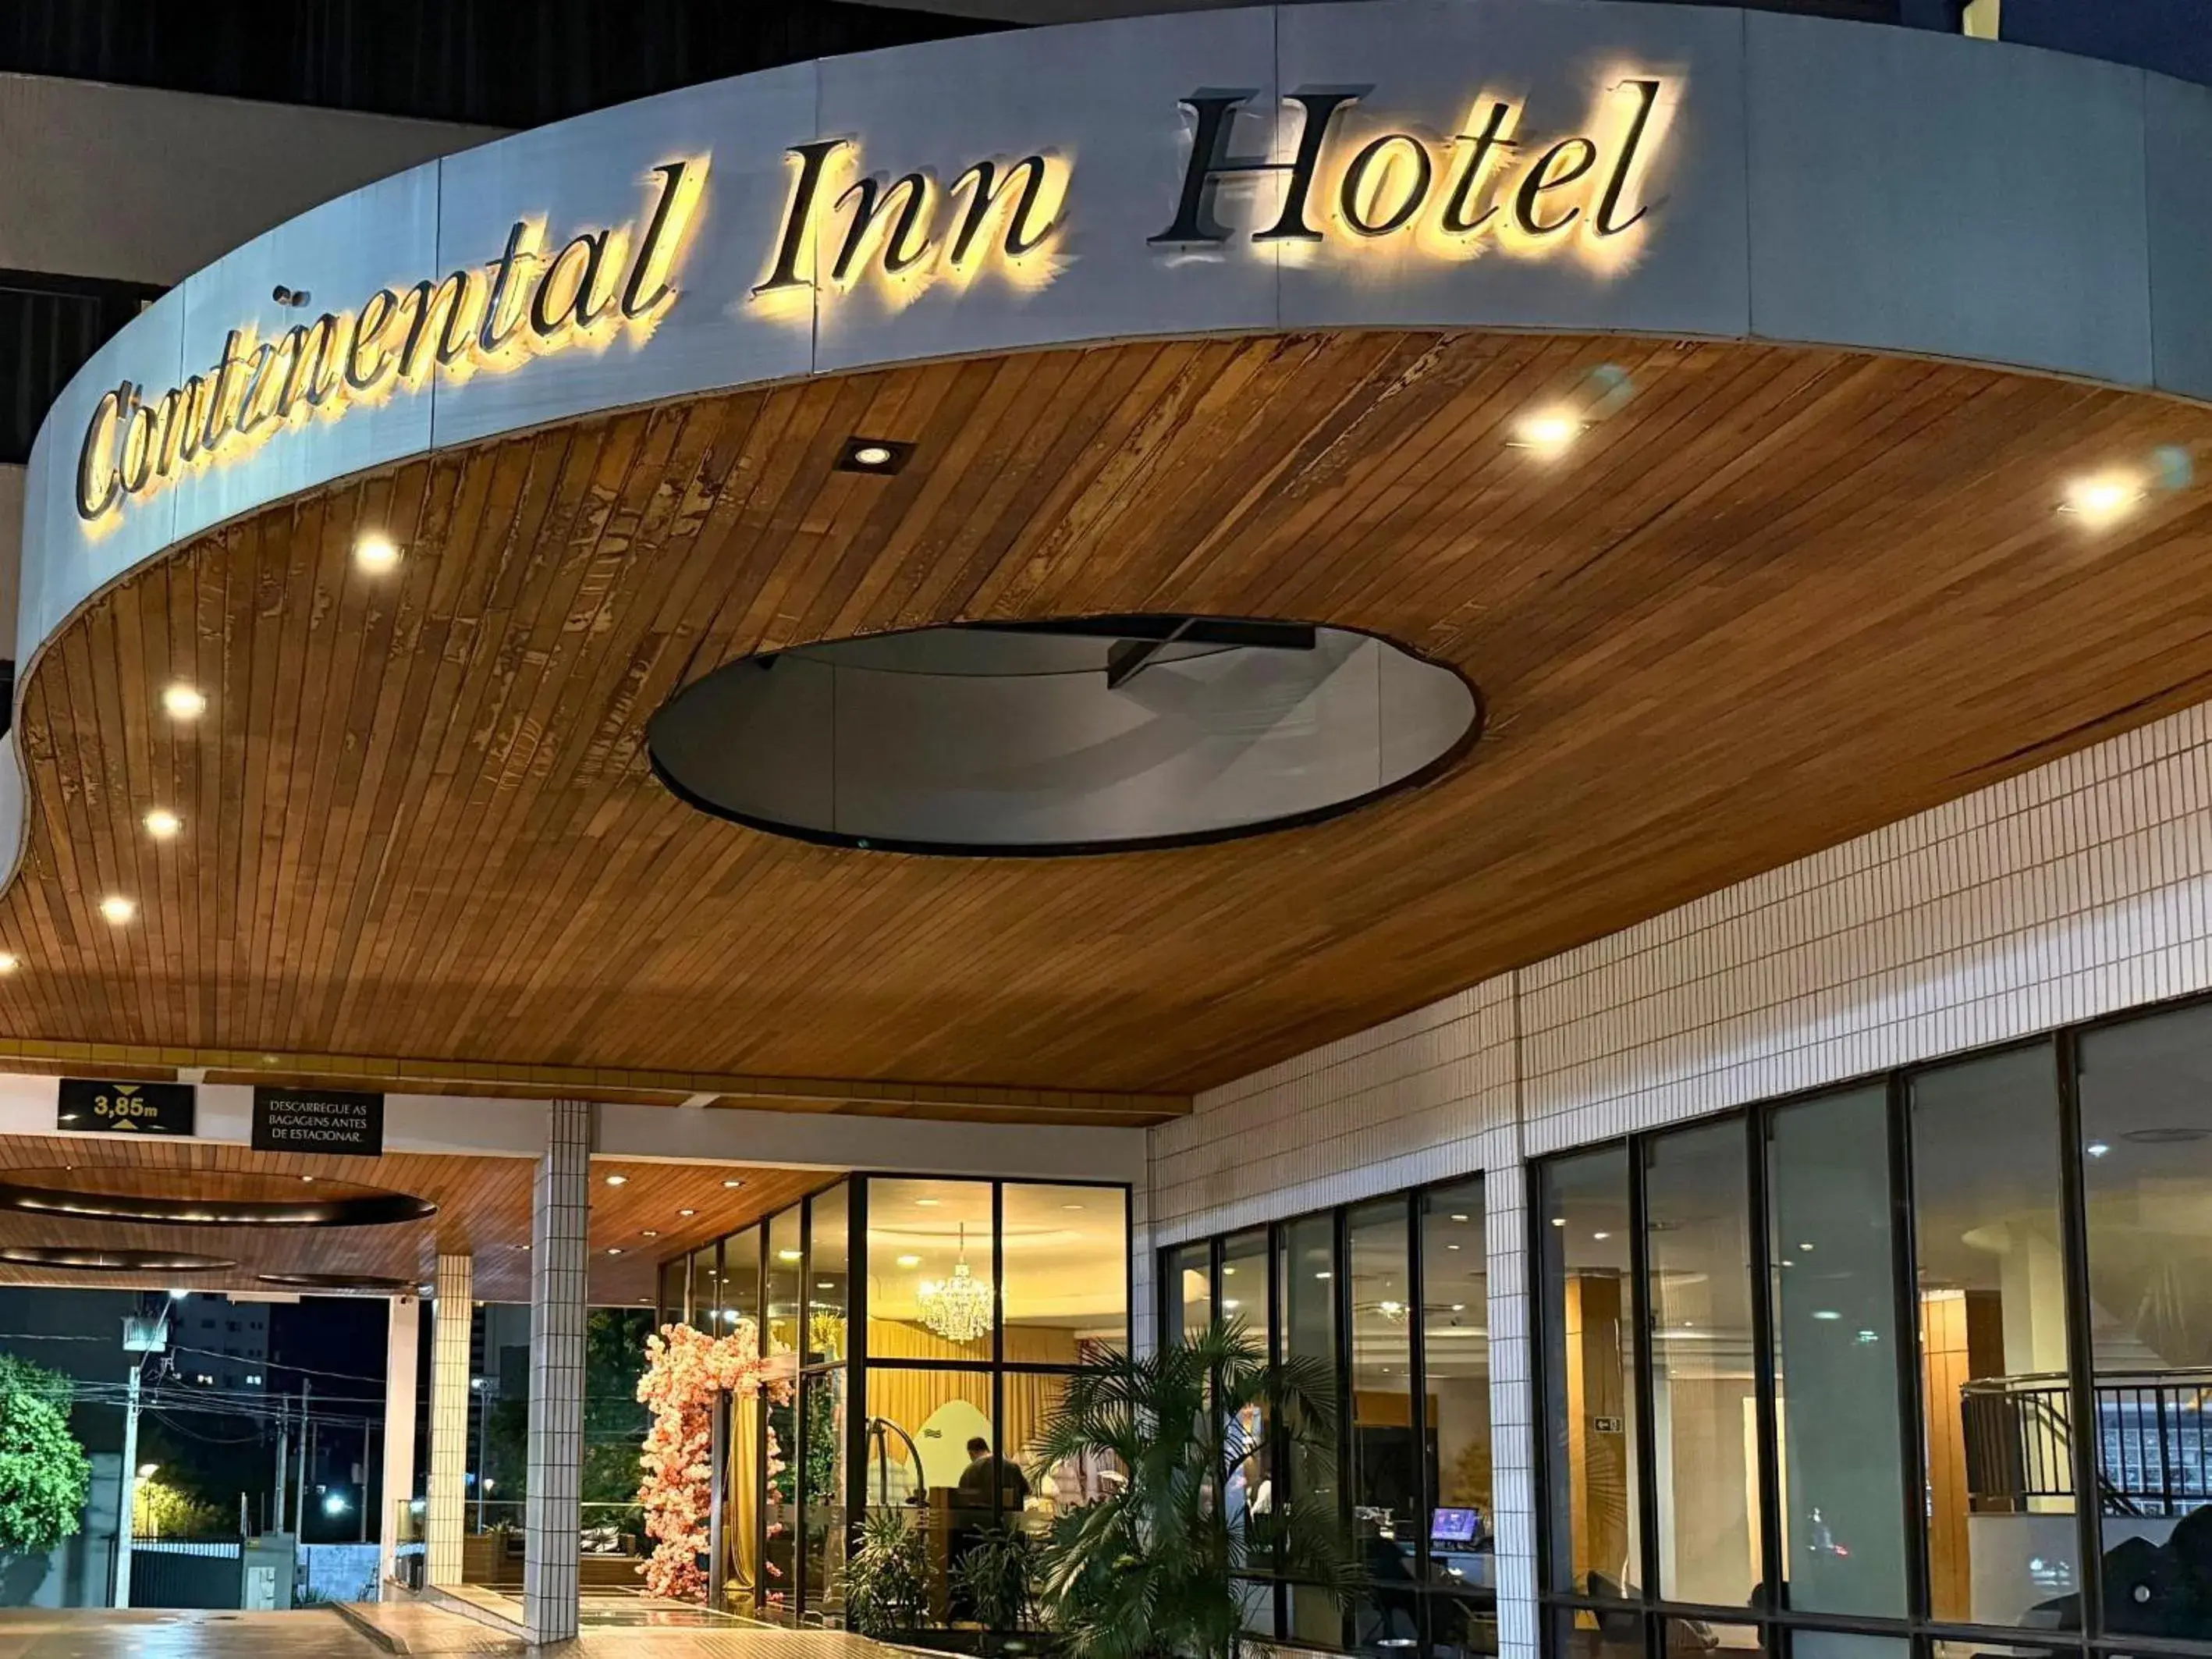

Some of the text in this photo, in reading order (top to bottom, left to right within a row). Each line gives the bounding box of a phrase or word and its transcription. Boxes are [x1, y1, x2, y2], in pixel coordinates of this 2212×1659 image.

[76, 79, 1667, 521] Continental Inn Hotel
[94, 1096, 158, 1119] 3,85m
[270, 1100, 367, 1115] DESCARREGUE AS
[268, 1114, 367, 1128] BAGAGENS ANTES
[272, 1128, 287, 1139] DE
